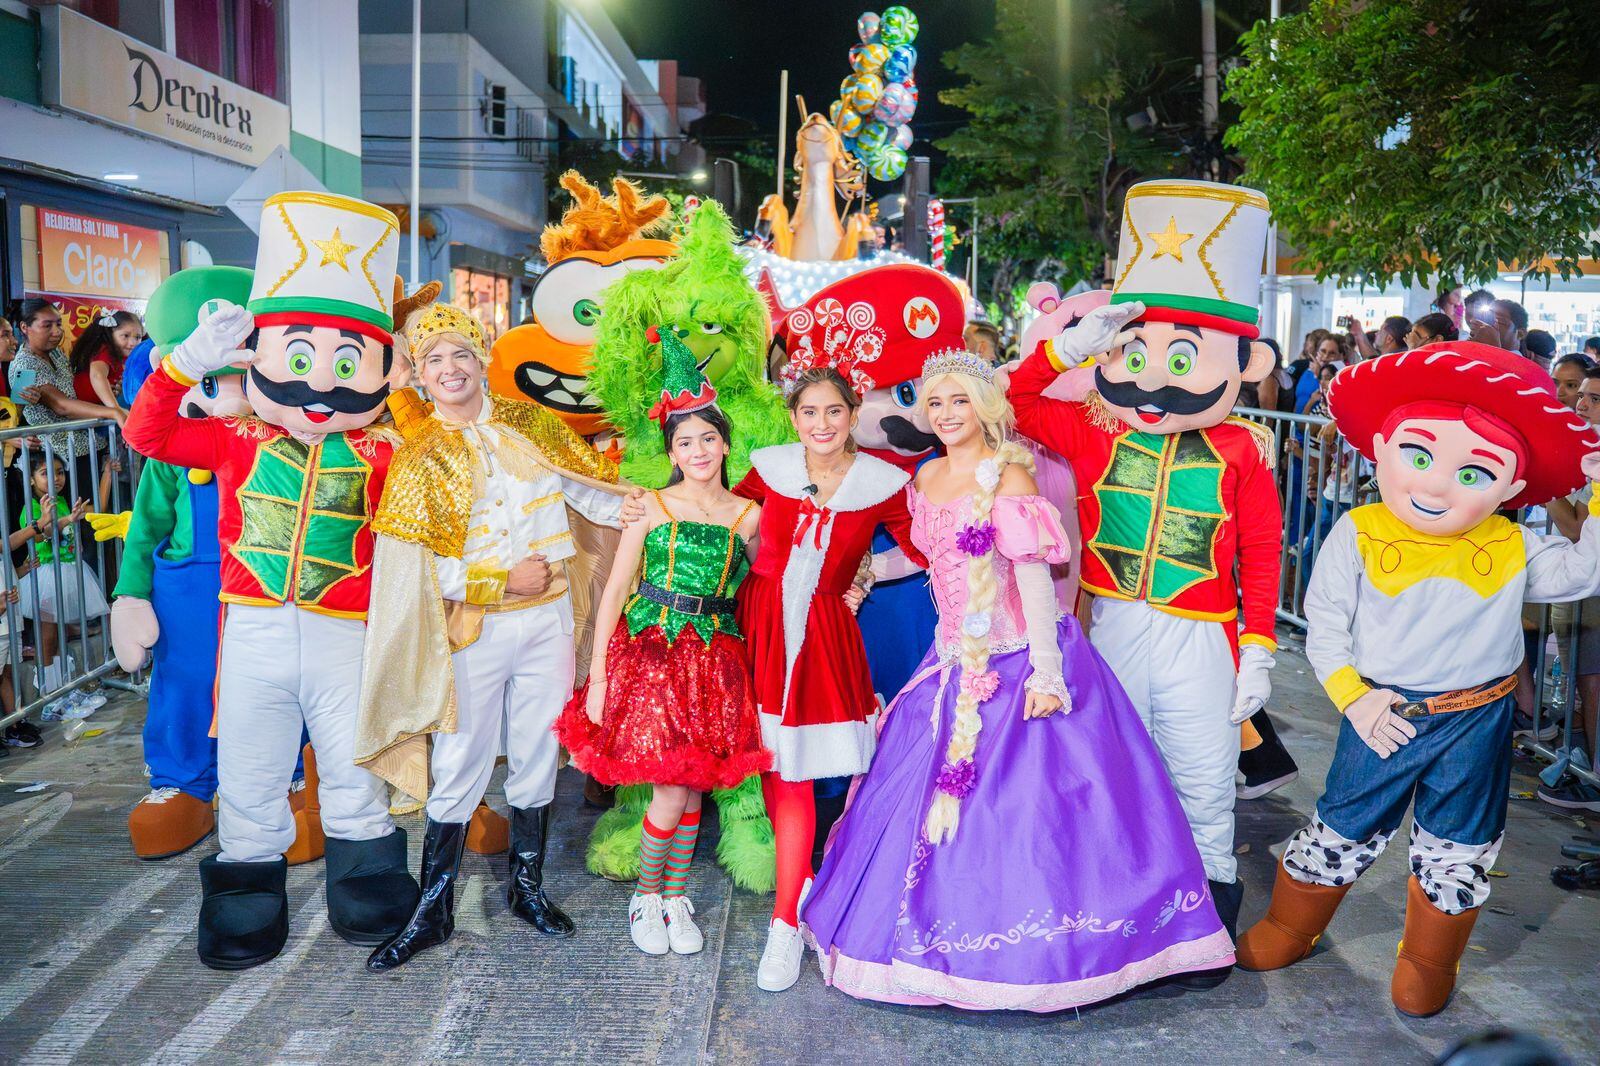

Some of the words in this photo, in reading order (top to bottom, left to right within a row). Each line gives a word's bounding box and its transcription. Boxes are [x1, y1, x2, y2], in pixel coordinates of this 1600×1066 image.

[122, 41, 252, 136] Decotex
[166, 113, 175, 125] Tu
[45, 212, 82, 233] RELOJERIA
[82, 219, 96, 235] SOL
[96, 222, 101, 236] Y
[102, 223, 119, 239] LUNA
[63, 241, 135, 291] Claro
[908, 304, 938, 331] M
